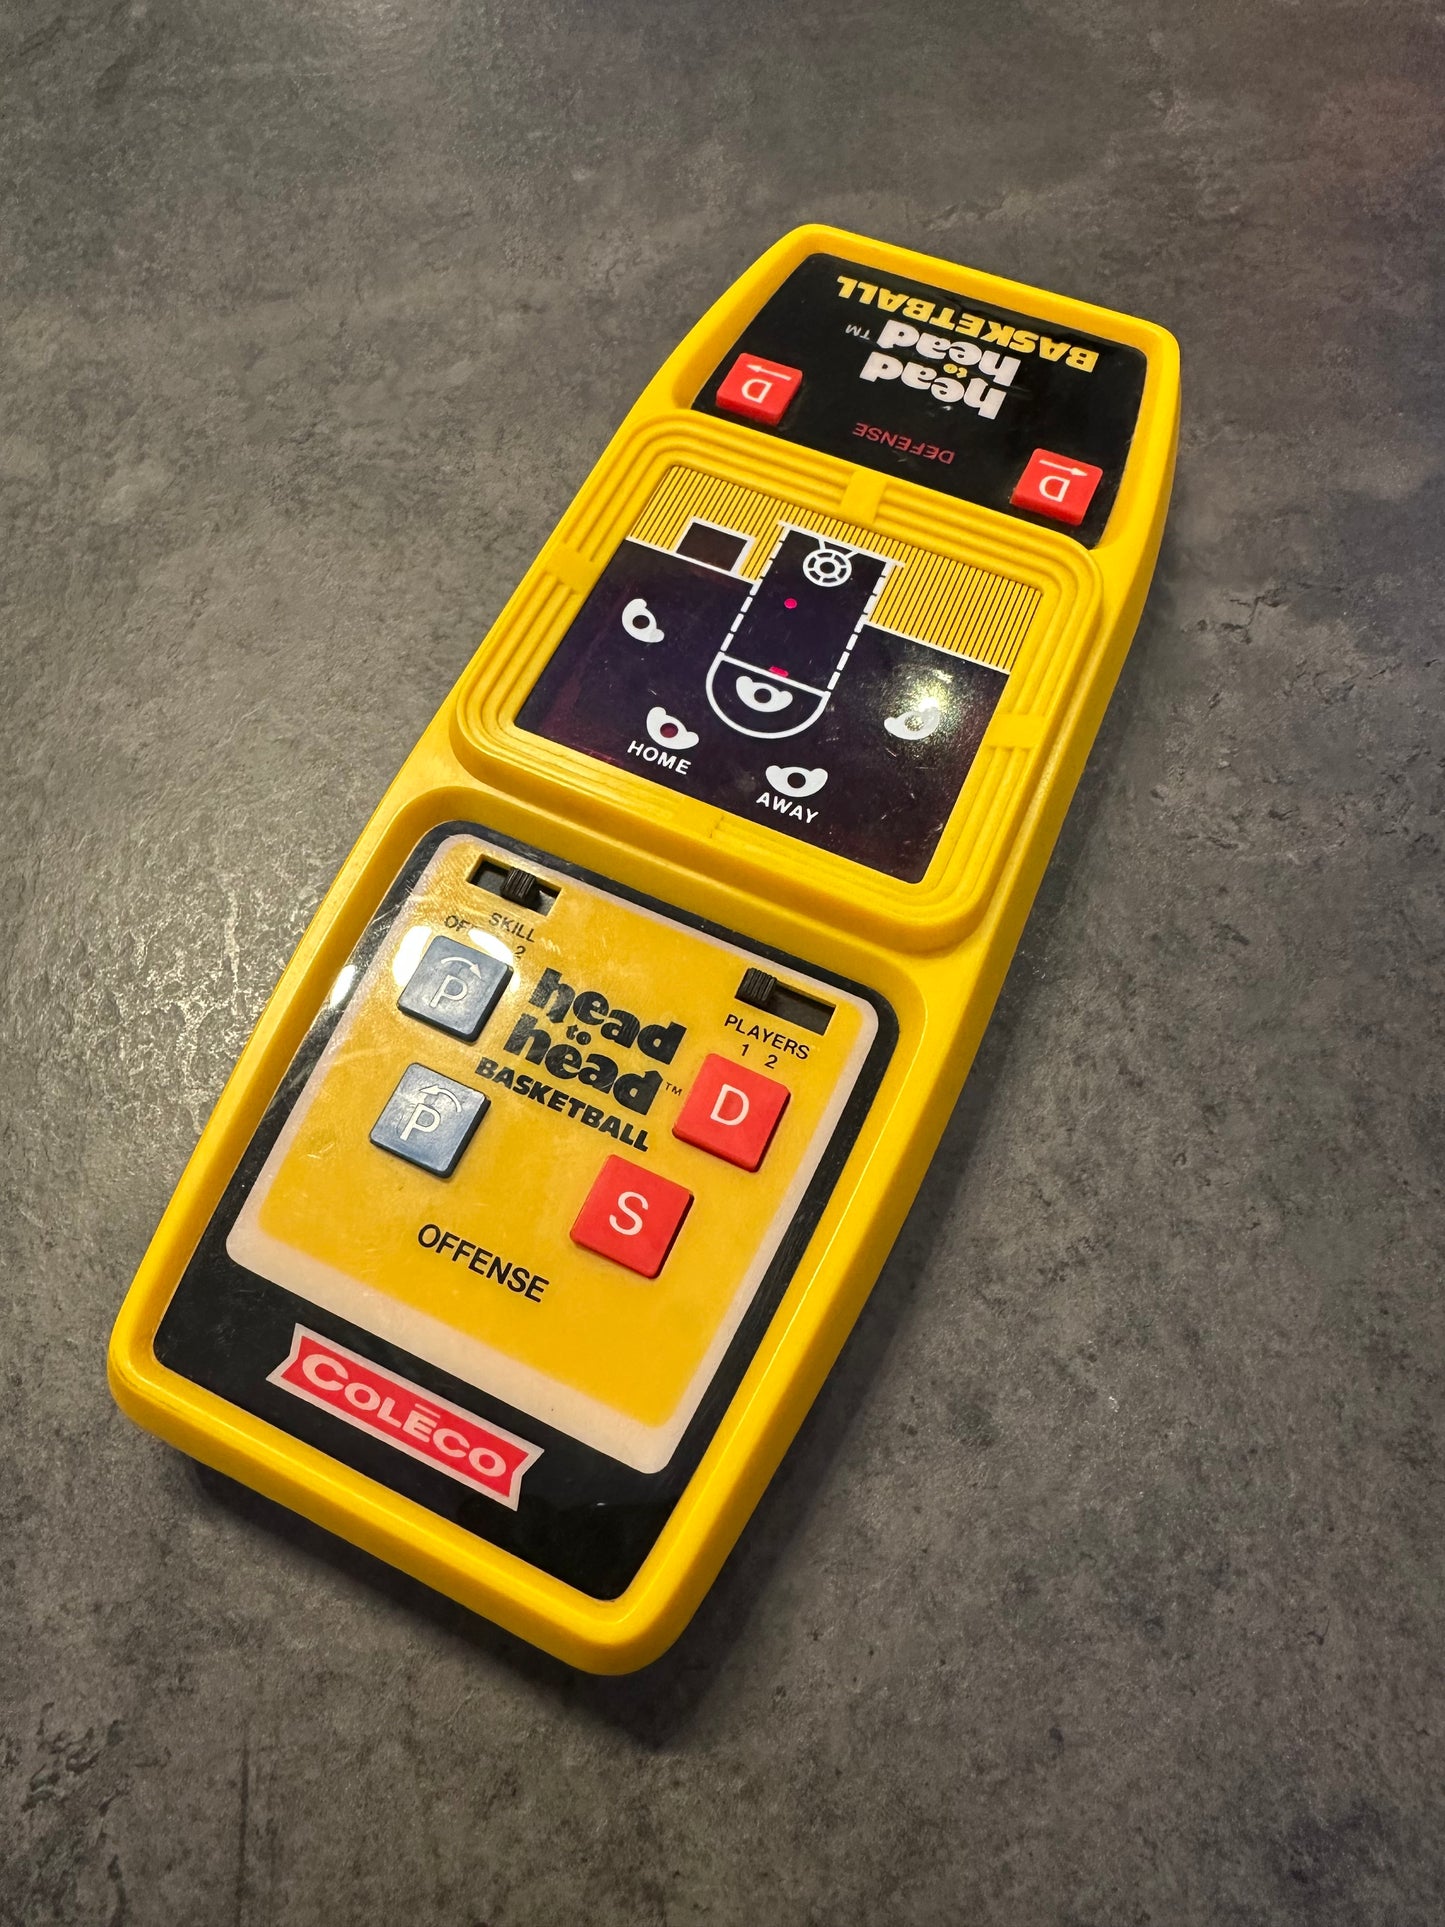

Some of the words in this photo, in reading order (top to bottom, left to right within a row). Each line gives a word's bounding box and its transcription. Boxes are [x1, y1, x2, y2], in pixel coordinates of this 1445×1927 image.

[836, 275, 1100, 373] BASKETBALL
[877, 320, 1023, 387] head
[943, 364, 968, 379] to
[741, 379, 771, 405] D
[860, 351, 1007, 420] head
[852, 421, 956, 465] DEFENSE
[1038, 475, 1069, 503] D
[627, 740, 692, 776] HOME
[756, 791, 820, 825] AWAY
[443, 914, 478, 934] OF
[488, 911, 536, 943] SKILL
[514, 946, 526, 959] 2
[430, 974, 469, 1009] P
[528, 967, 687, 1065] head
[565, 1024, 592, 1046] to
[724, 1013, 810, 1060] PLAYERS
[503, 1013, 664, 1116] head
[741, 1043, 750, 1057] 1
[764, 1054, 779, 1070] 2
[400, 1103, 442, 1141] P
[474, 1056, 651, 1153] BASKETBALL
[710, 1083, 751, 1126] D
[608, 1190, 650, 1237] S
[417, 1223, 551, 1303] OFFENSE
